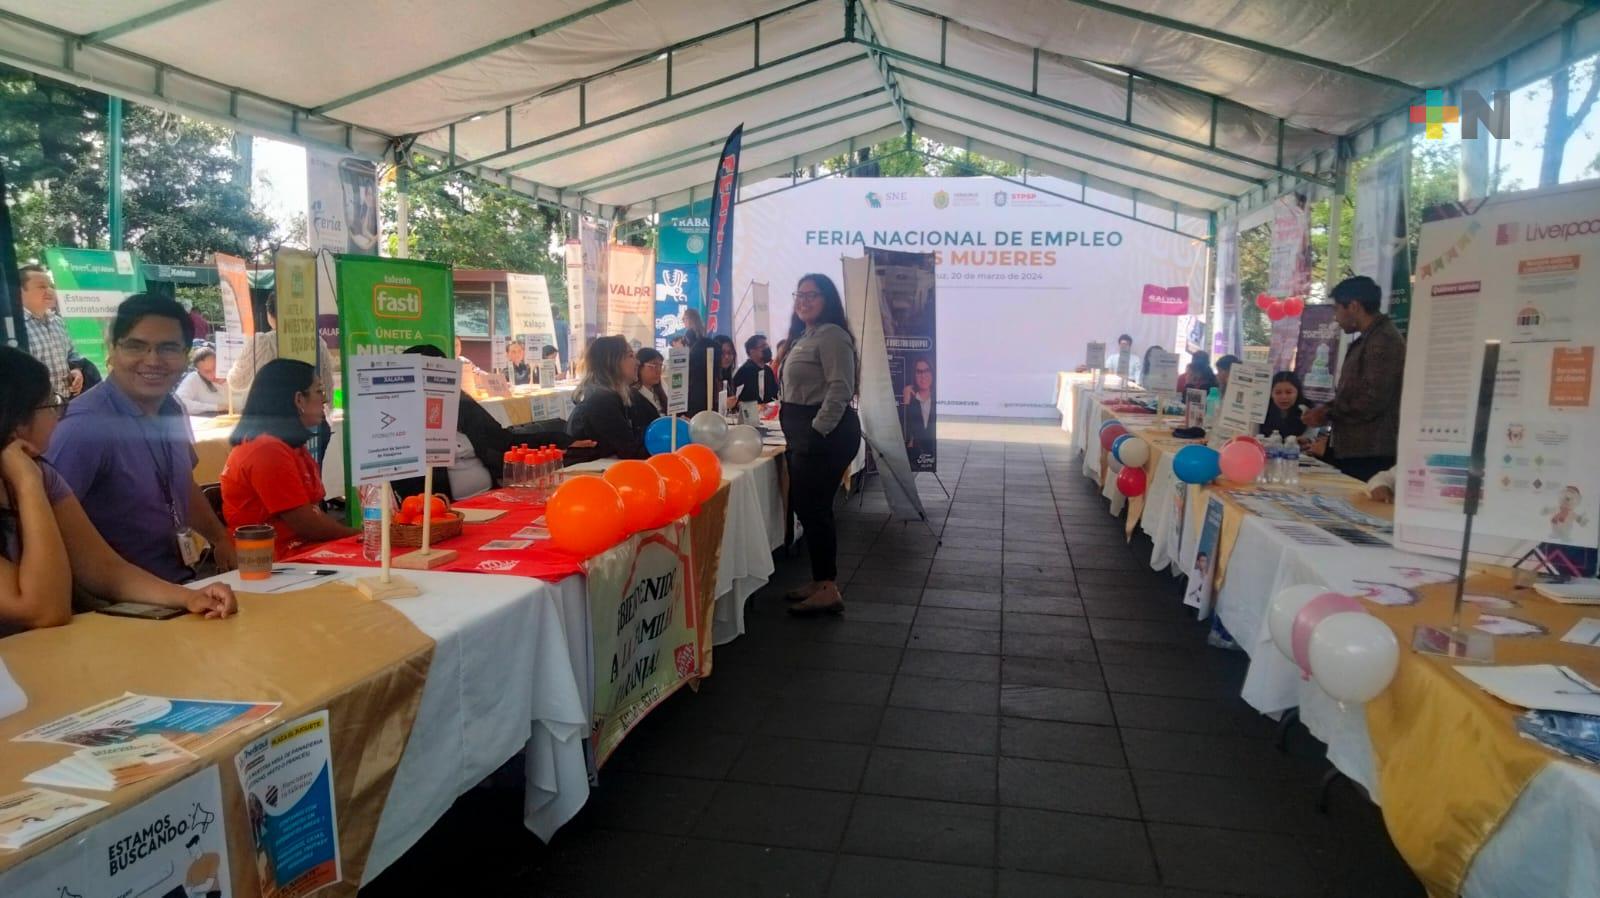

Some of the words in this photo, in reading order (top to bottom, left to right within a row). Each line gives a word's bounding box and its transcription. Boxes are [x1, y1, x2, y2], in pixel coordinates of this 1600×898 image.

[886, 191, 908, 201] SNE
[671, 217, 710, 228] TRABA
[805, 230, 865, 246] FERIA
[873, 230, 987, 246] NACIONAL
[994, 231, 1023, 247] DE
[1031, 231, 1123, 247] EMPLEO
[950, 250, 1057, 266] MUJERES
[951, 272, 963, 281] 20
[963, 272, 976, 281] de
[977, 273, 1006, 281] marzo
[1007, 272, 1020, 281] de
[1021, 272, 1043, 281] 2024
[377, 290, 420, 313] fasti
[1148, 295, 1184, 304] SALIDA
[375, 326, 412, 340] ÚNETE
[414, 329, 423, 340] A
[108, 814, 170, 860] ESTAMOS
[110, 819, 188, 877] BUSCANDO
